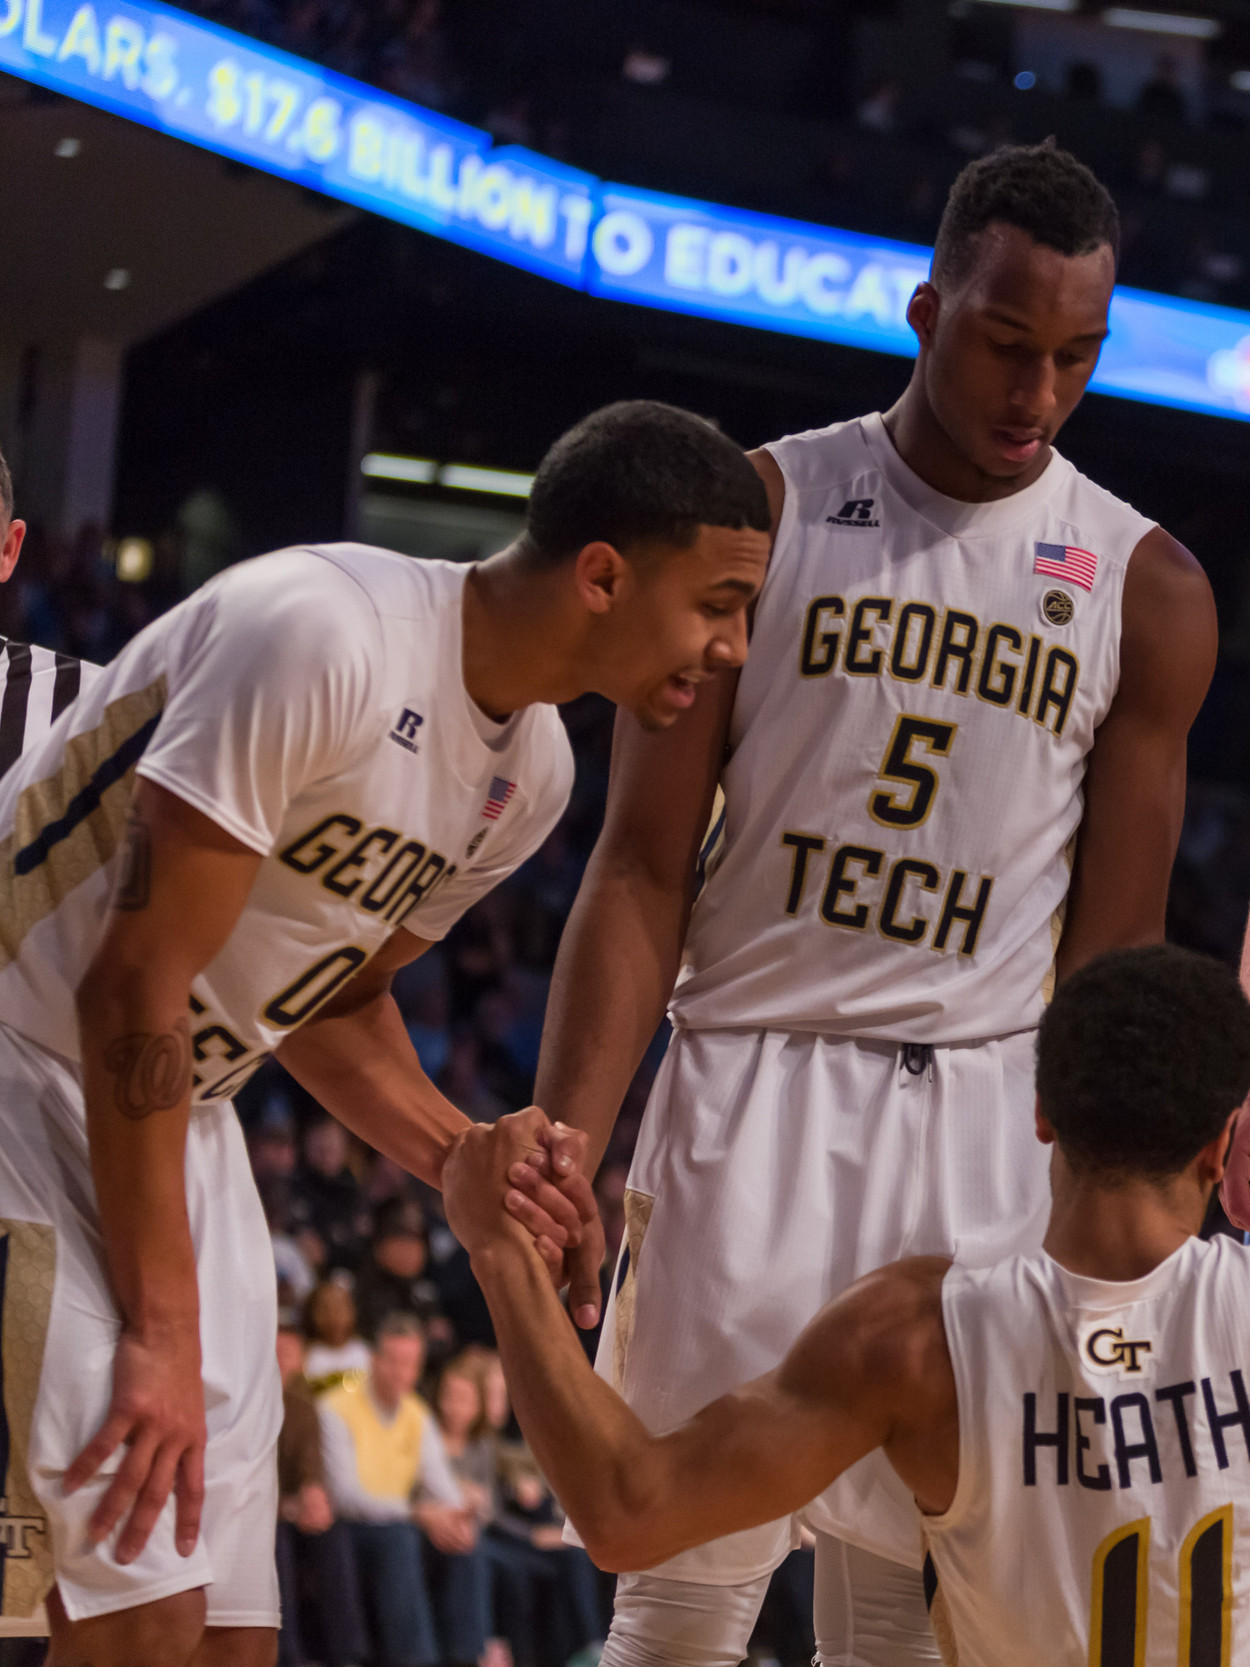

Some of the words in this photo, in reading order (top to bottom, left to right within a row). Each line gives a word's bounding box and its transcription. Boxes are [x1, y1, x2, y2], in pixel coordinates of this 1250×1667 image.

[348, 112, 557, 248] BILLION
[560, 194, 653, 277] TO
[800, 595, 1080, 739] GEORGIA
[867, 712, 959, 831] 5
[278, 811, 459, 928] GEOR
[780, 830, 999, 958] TECH
[260, 944, 371, 1033] 0
[1086, 1327, 1152, 1372] GT
[1088, 1501, 1234, 1667] 11
